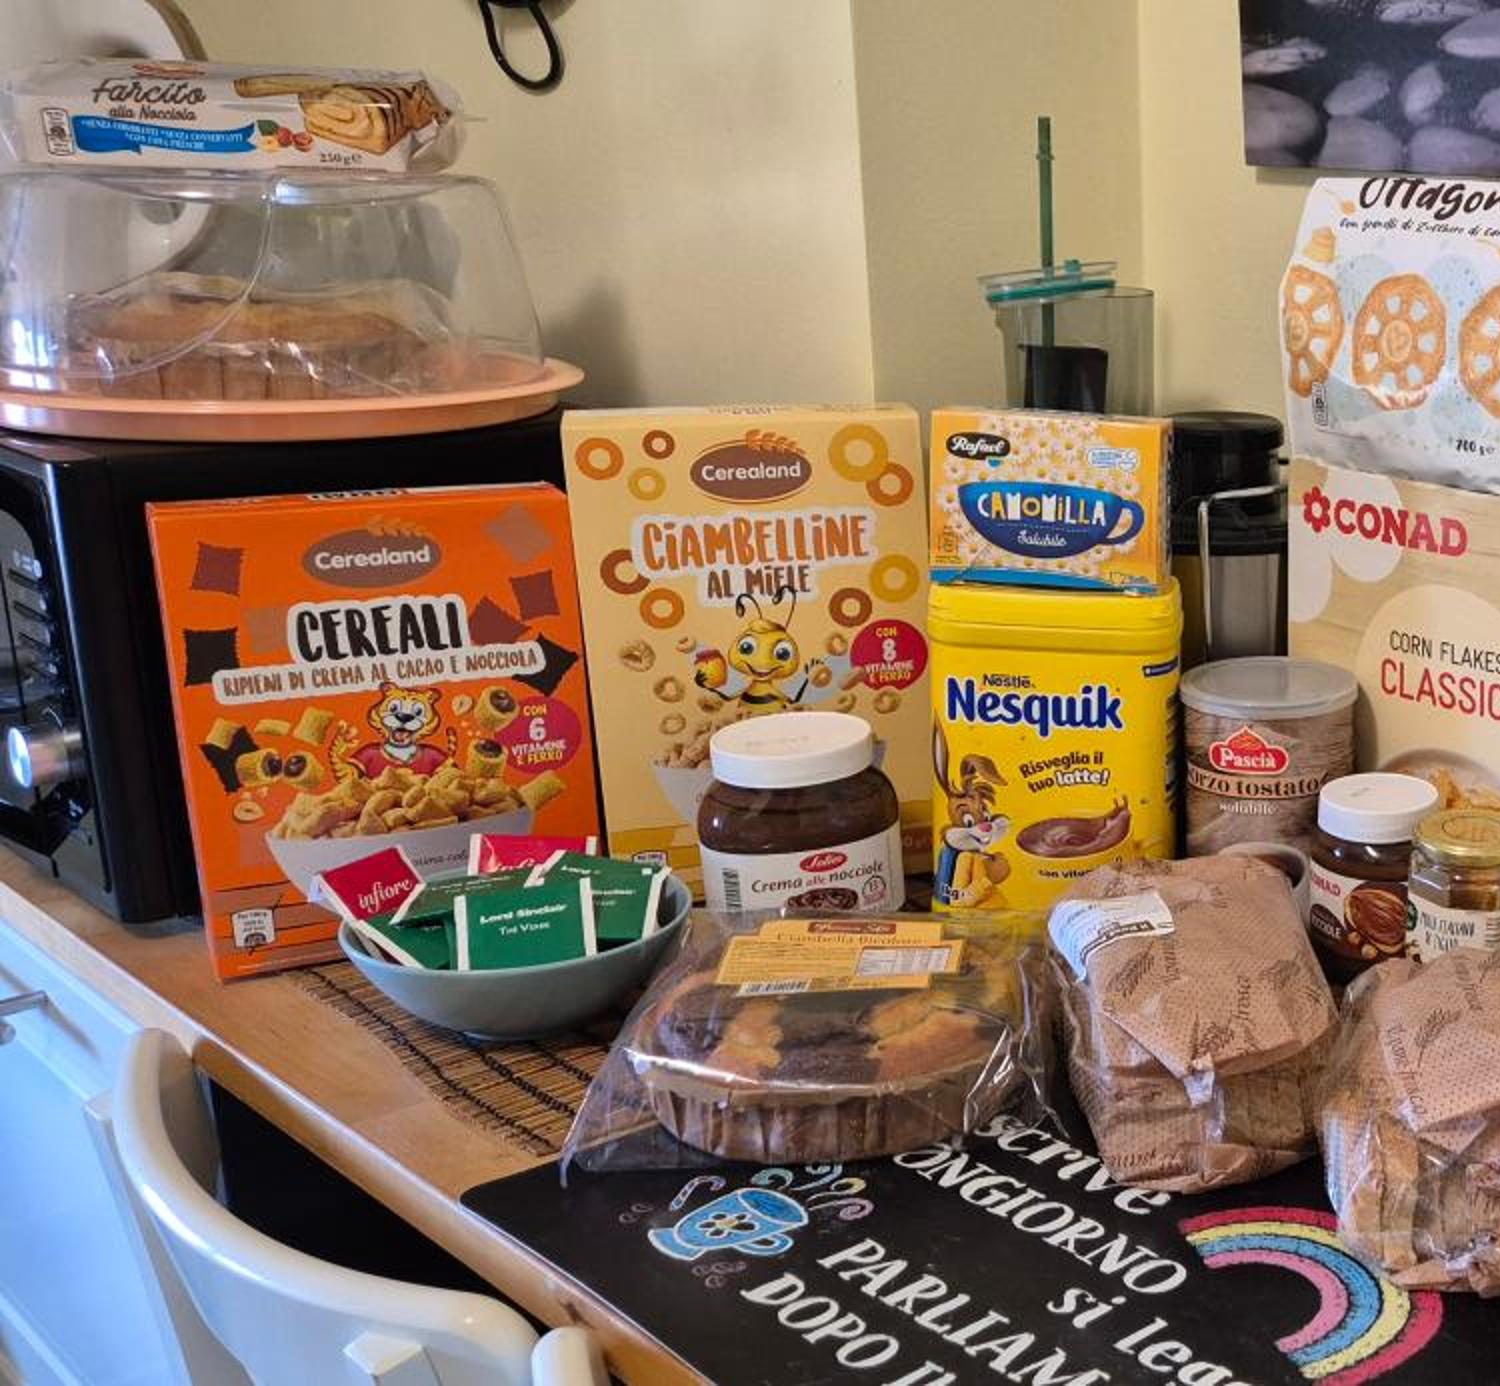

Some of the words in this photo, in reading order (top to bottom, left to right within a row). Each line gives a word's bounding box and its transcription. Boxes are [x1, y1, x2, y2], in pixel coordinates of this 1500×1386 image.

[139, 106, 197, 121] Nocciola
[1401, 220, 1412, 232] di
[1468, 225, 1479, 237] di
[701, 461, 801, 482] Cerealand
[1334, 498, 1469, 557] CONAD
[314, 545, 431, 570] Cerealand
[707, 570, 732, 599] AL
[296, 600, 463, 663] CEREALI
[882, 637, 897, 662] 8
[1389, 630, 1434, 660] CORN
[222, 670, 283, 698] RIPIENI
[289, 669, 306, 691] DI
[311, 664, 365, 689] CREMA
[370, 662, 390, 683] AL
[398, 655, 445, 680] CACAO
[451, 655, 459, 673] E
[464, 648, 538, 672] NOCCIOLA
[523, 703, 547, 717] CON
[947, 677, 1124, 737] Nesquik
[529, 716, 547, 741] 6
[1019, 751, 1088, 779] Risveglia
[1090, 751, 1104, 765] il
[1219, 748, 1277, 769] Pascià
[1027, 777, 1054, 793] tuo
[1055, 768, 1111, 786] latte!
[1235, 774, 1320, 797] tostato
[751, 877, 803, 894] Crema
[829, 859, 884, 883] nocciole
[480, 911, 513, 925] Lord
[515, 903, 568, 918] Sinclair
[893, 1142, 1188, 1294] ONGIORNO
[740, 1272, 900, 1368] DOPO
[1047, 1287, 1127, 1329] si
